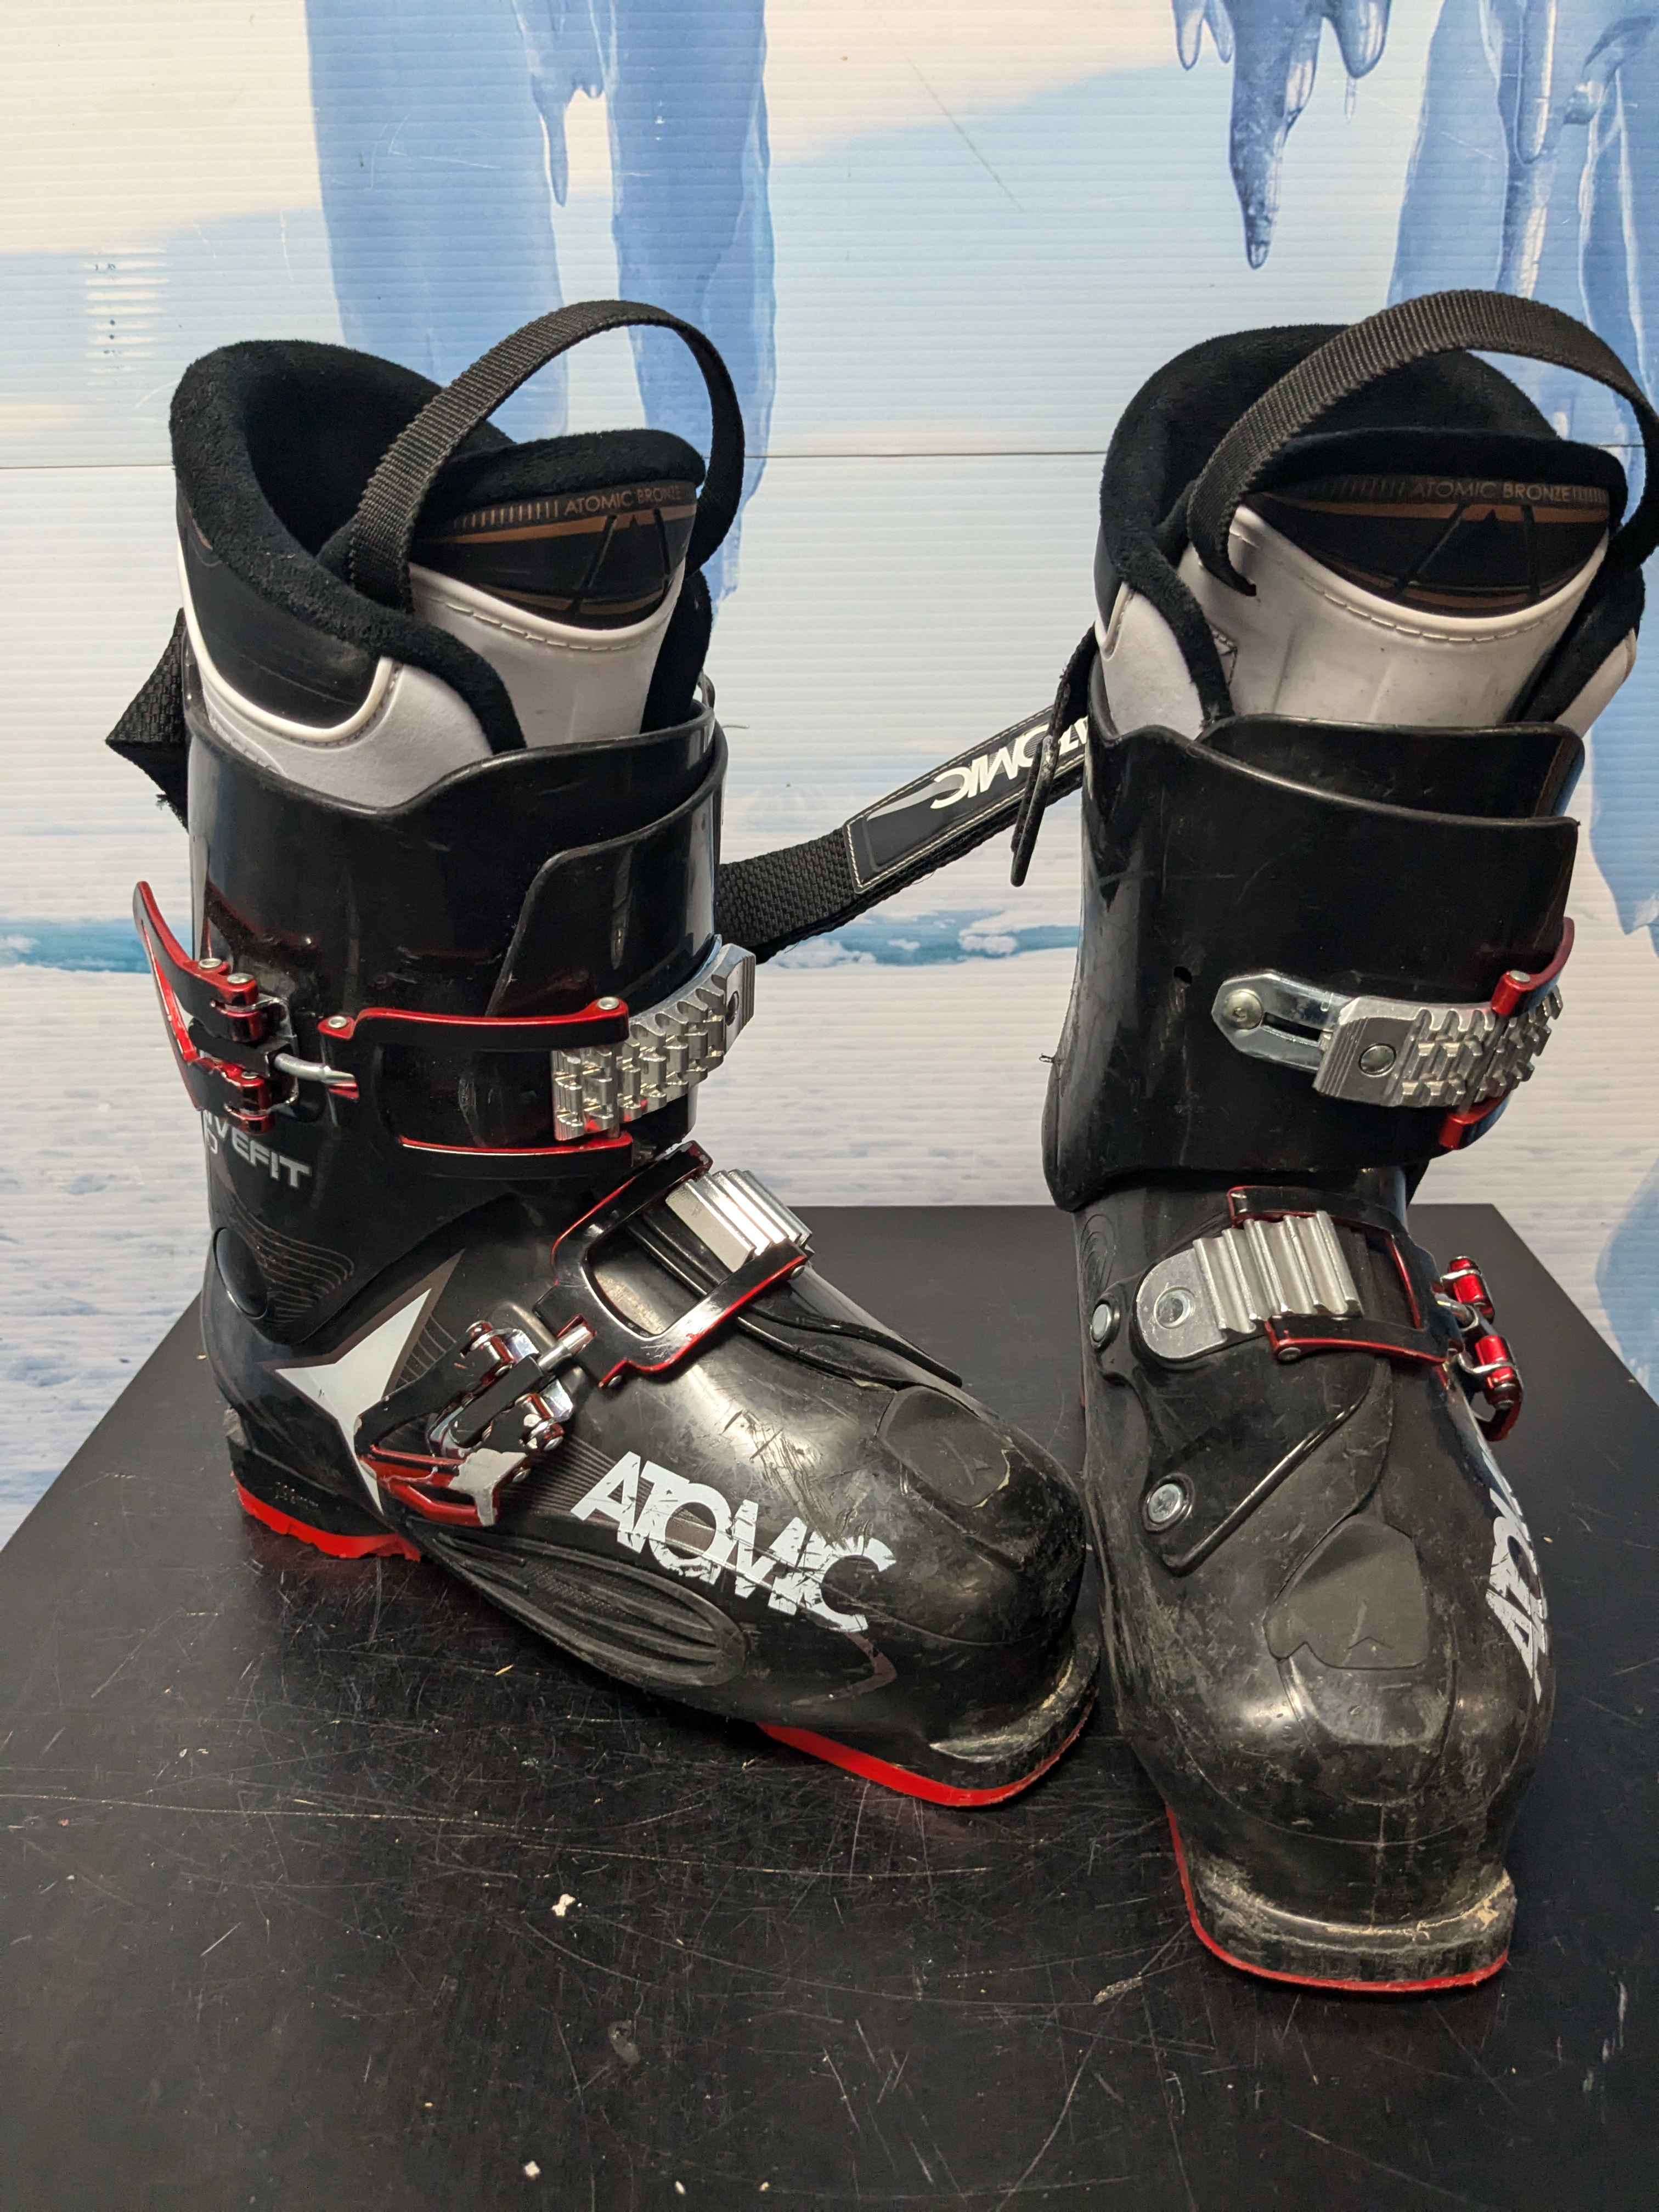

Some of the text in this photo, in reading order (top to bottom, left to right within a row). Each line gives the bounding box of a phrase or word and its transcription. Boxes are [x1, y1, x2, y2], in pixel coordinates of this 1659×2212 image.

[563, 489, 634, 517] ATOMIC
[1412, 480, 1572, 502] ATOMIC BRONZE
[570, 1451, 896, 1632] ATOMIC
